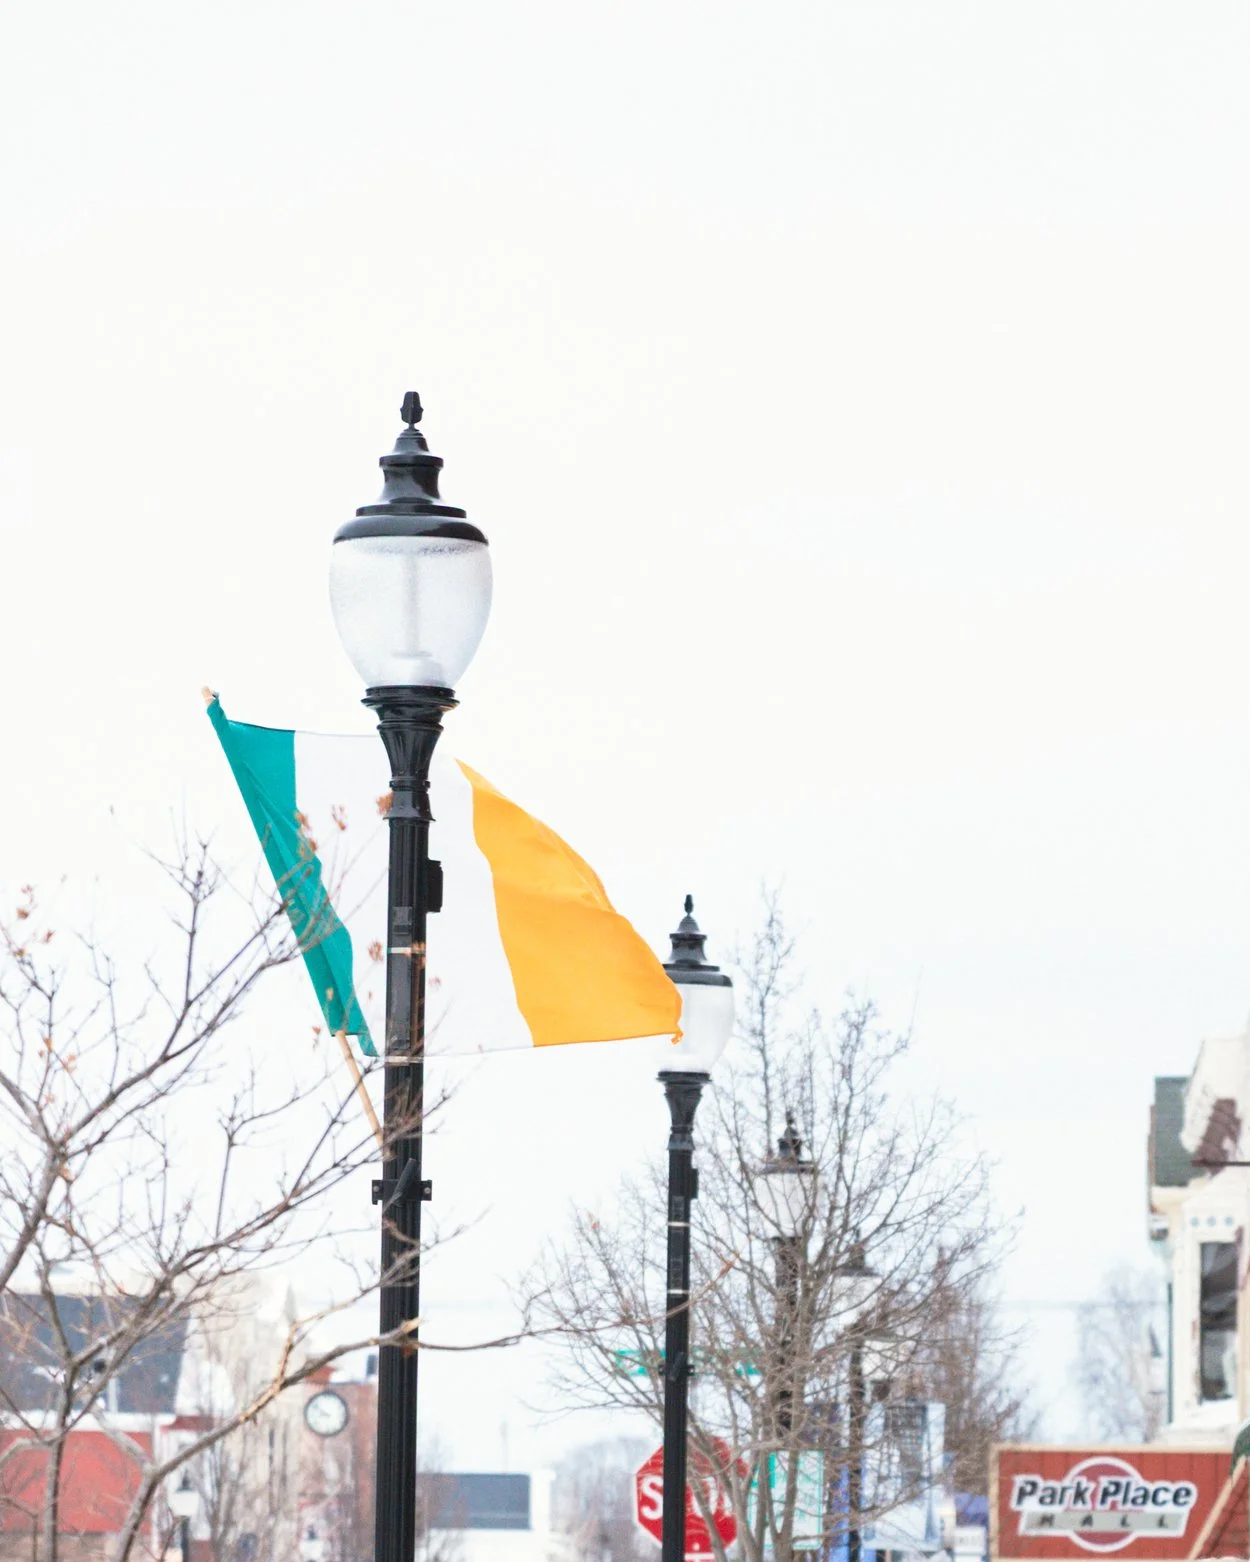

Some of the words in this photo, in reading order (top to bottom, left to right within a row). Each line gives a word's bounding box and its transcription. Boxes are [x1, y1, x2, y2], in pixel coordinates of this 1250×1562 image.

[1015, 1480, 1092, 1506] Park
[1100, 1480, 1192, 1506] Place
[1039, 1515, 1168, 1528] MALL
